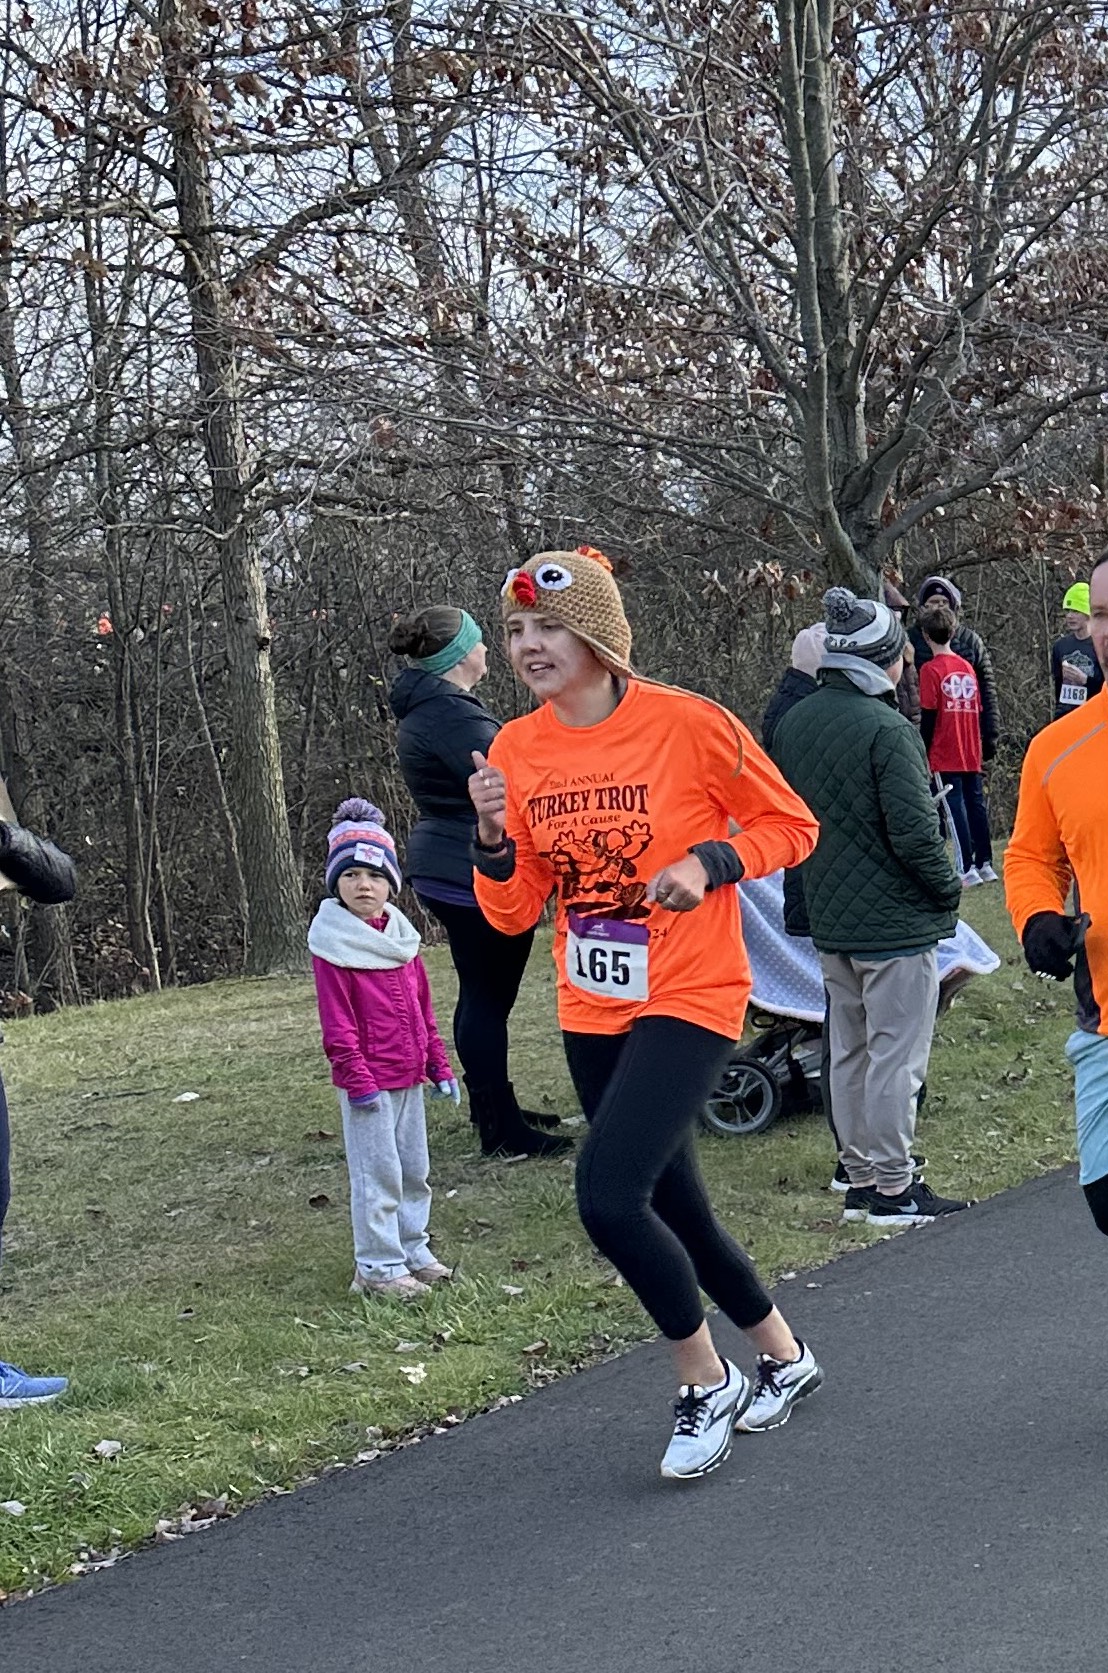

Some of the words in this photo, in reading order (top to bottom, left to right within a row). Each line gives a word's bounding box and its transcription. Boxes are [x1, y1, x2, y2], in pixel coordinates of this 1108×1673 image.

[1062, 687, 1085, 701] 1168
[569, 772, 616, 788] ANNUAL
[528, 789, 591, 829] TURKEY
[594, 784, 649, 815] TROT
[547, 819, 567, 831] For
[570, 817, 579, 828] A
[581, 814, 621, 827] Cause
[576, 945, 630, 986] 165
